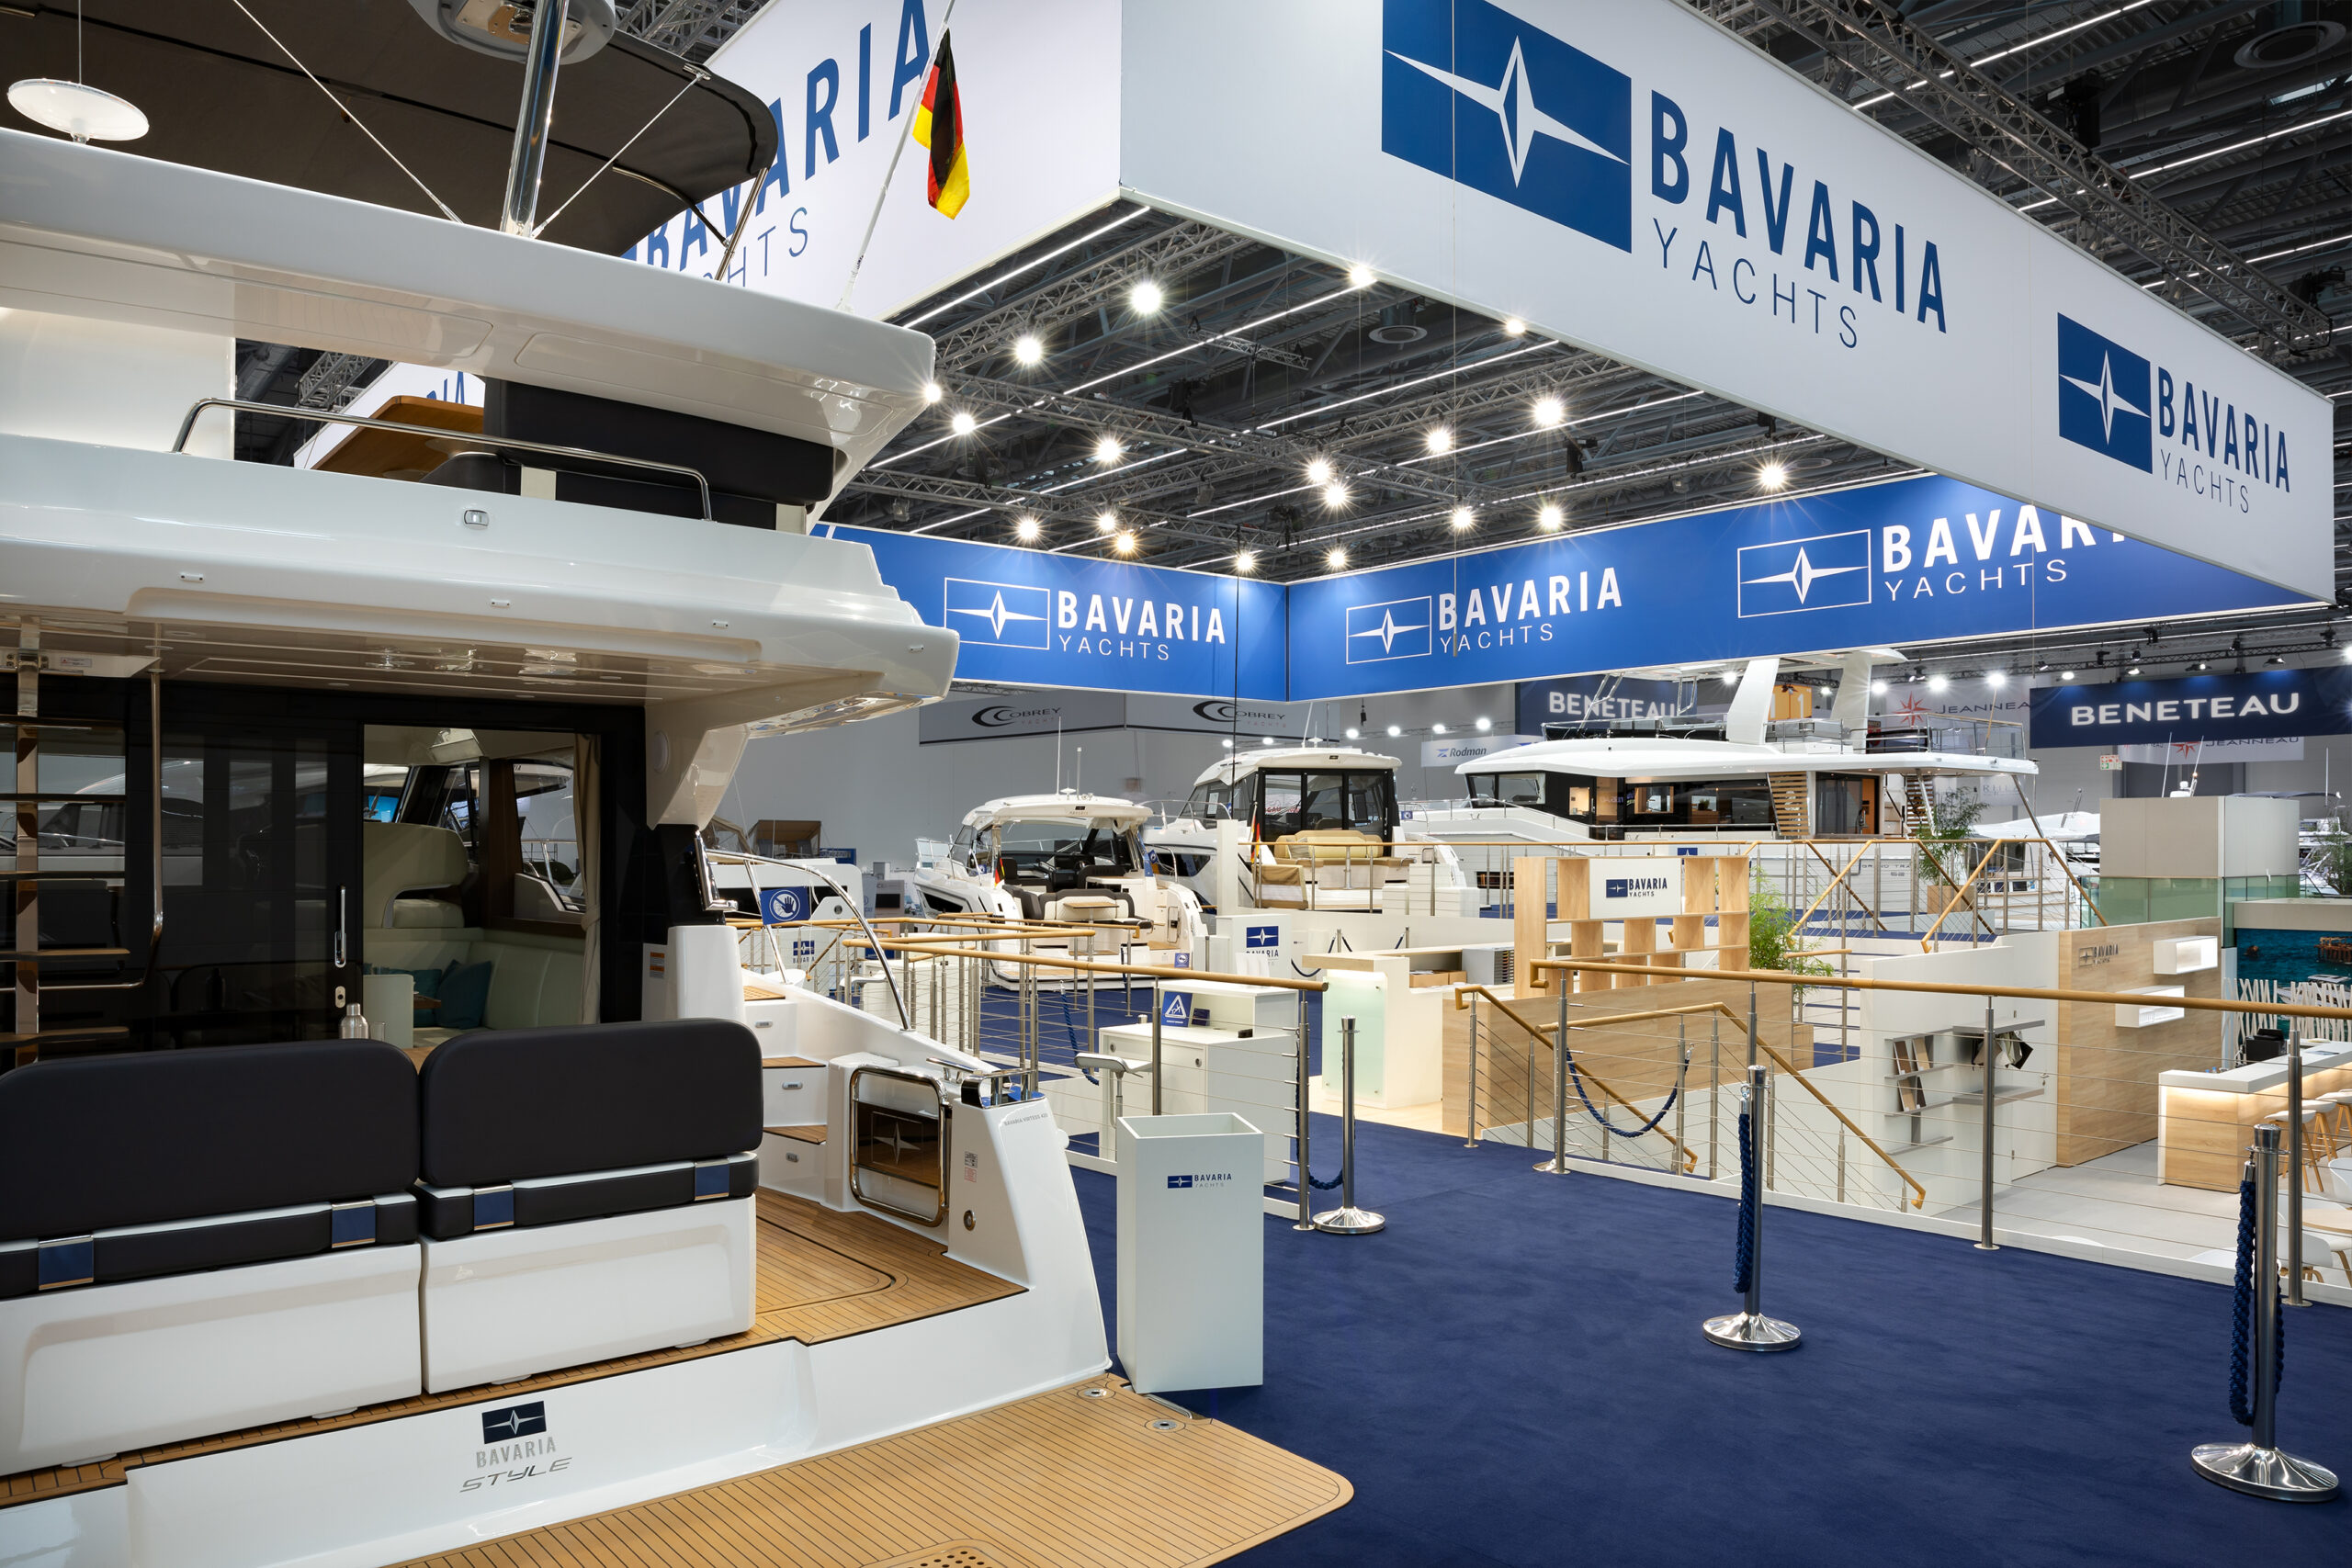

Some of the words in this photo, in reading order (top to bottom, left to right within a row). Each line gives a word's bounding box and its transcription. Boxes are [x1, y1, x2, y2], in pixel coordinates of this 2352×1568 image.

[1651, 89, 1947, 333] BAVARIA
[1654, 218, 1857, 348] YACHTS
[2159, 367, 2290, 493] BAVARIA
[2160, 448, 2250, 513] YACHTS
[1883, 503, 2124, 573] BAVAR
[1884, 558, 2067, 602] YACHTS
[1439, 568, 1623, 631] BAVARIA
[1057, 591, 1226, 644] BAVARIA
[1058, 635, 1170, 660] YACHTS
[1440, 624, 1555, 654] YACHTS
[1549, 691, 1679, 718] BENETEAU
[2071, 693, 2299, 726] BENETEAU
[1450, 747, 1487, 757] Rodman
[1629, 877, 1668, 890] BAVARIA
[2094, 943, 2119, 958] BAVARIA
[1194, 1173, 1232, 1182] BAVARIA
[476, 1436, 556, 1469] BAVARIA
[459, 1457, 572, 1493] STYLE
